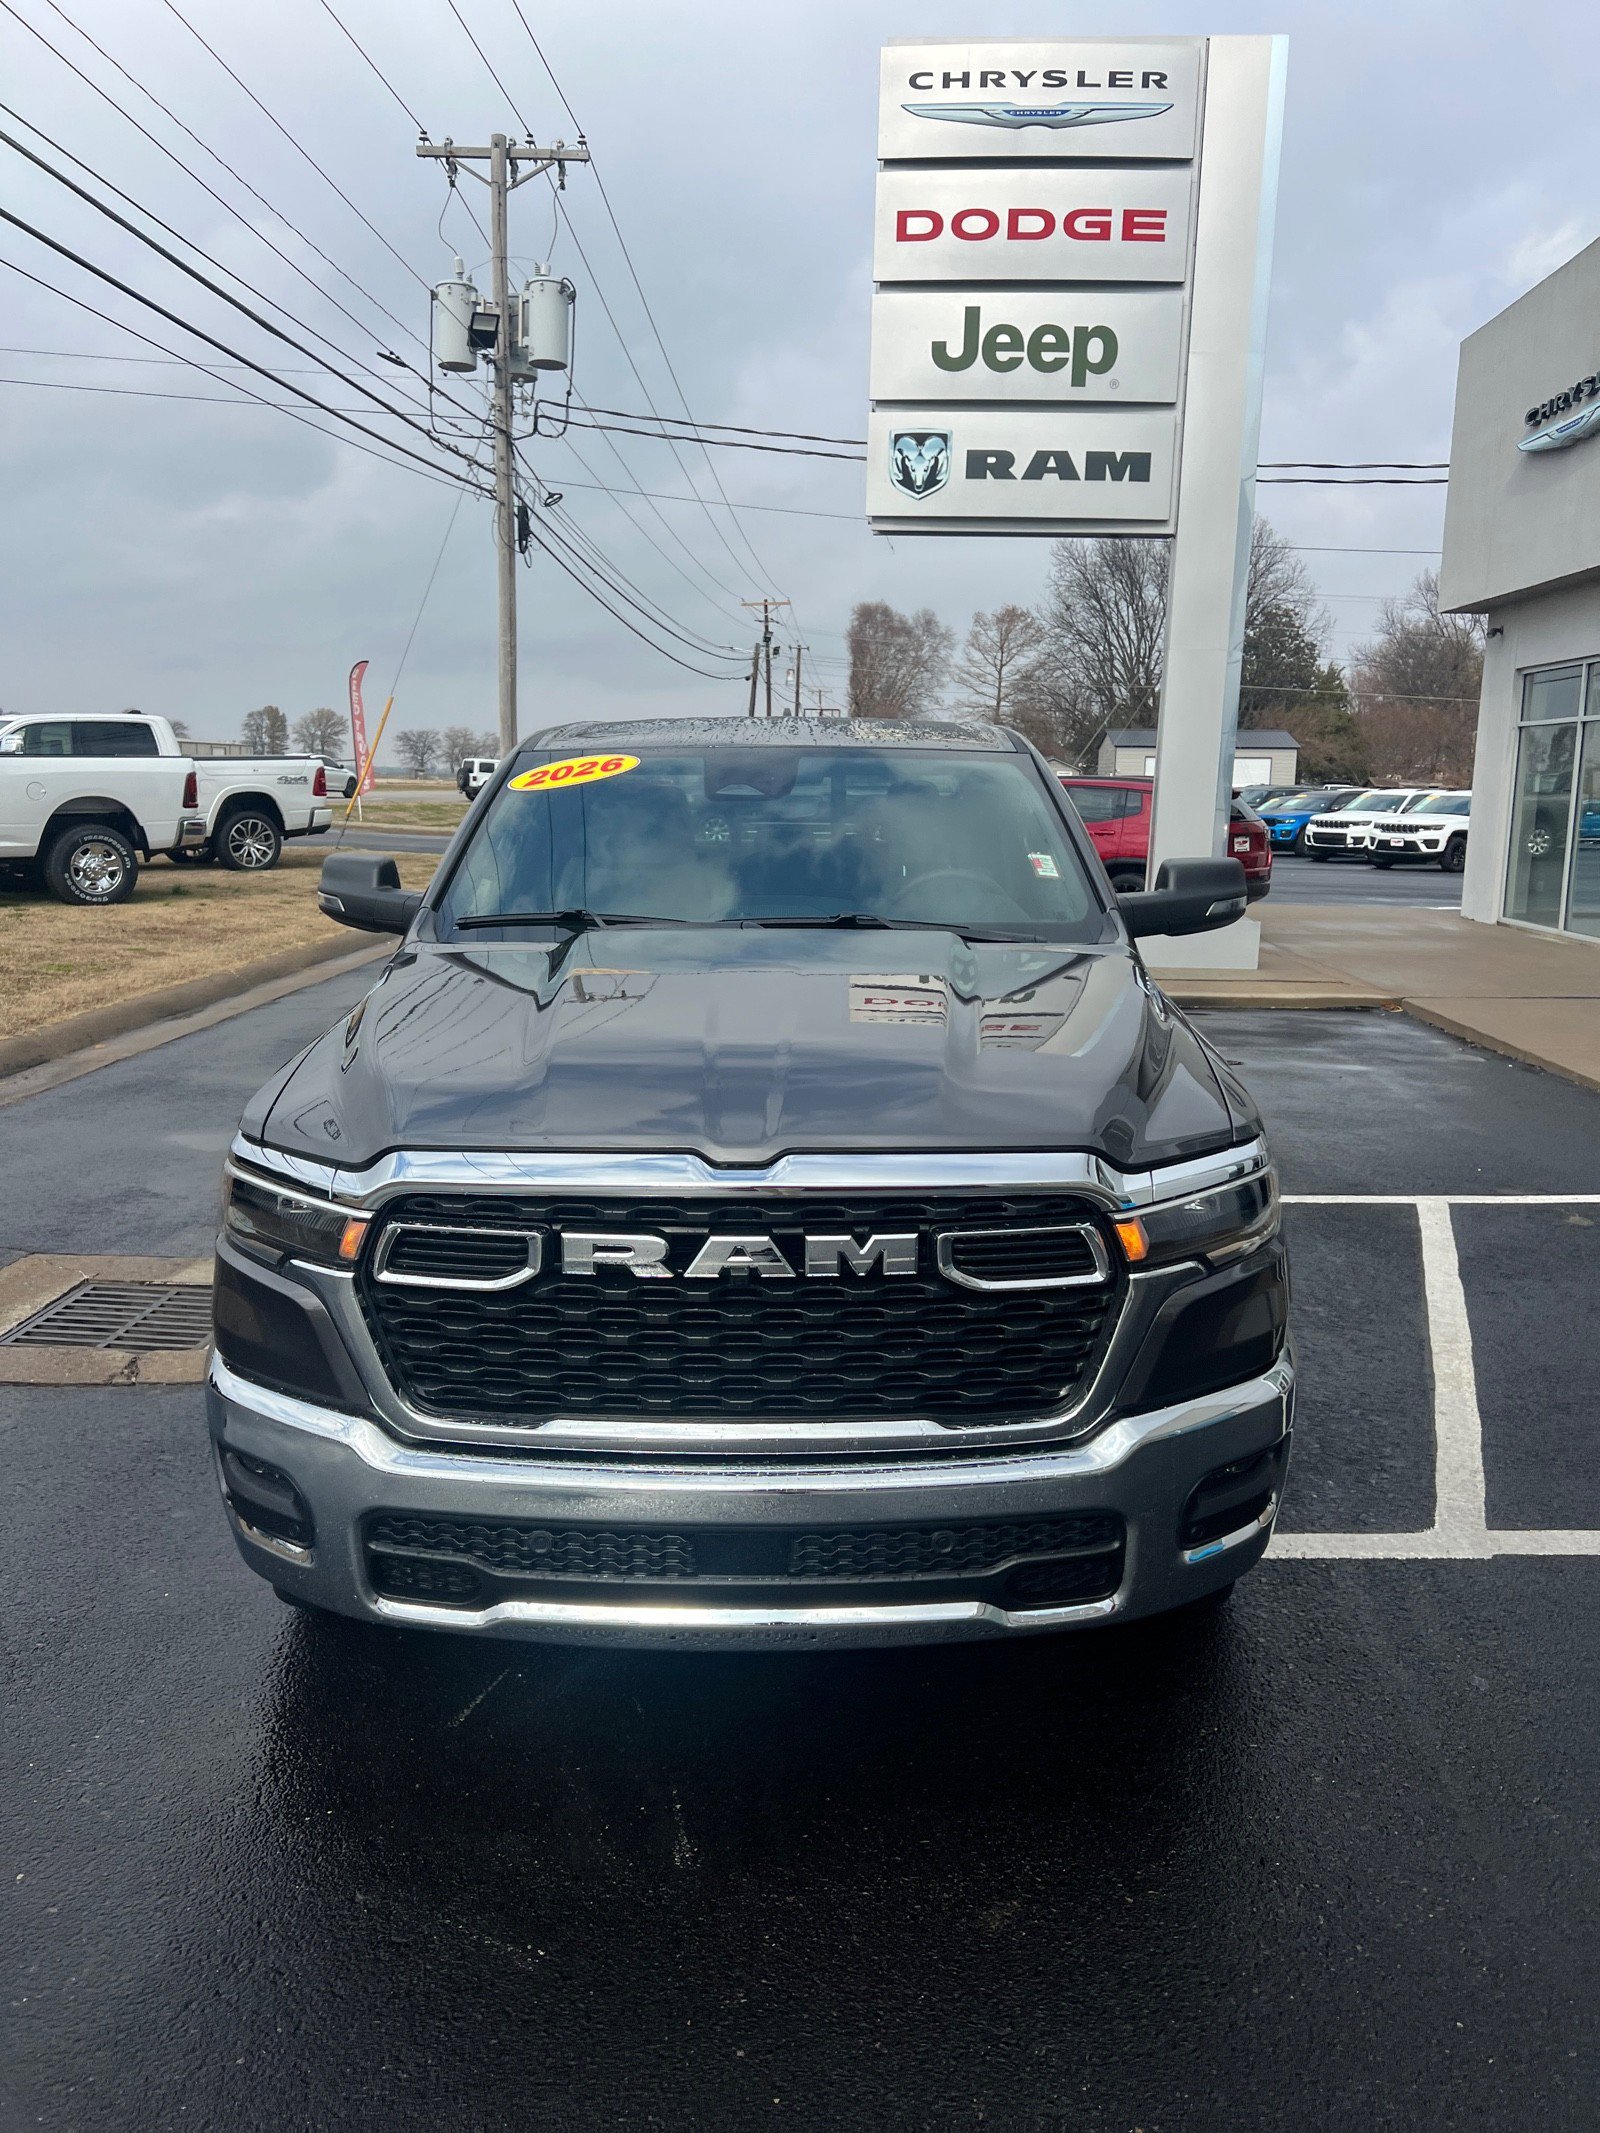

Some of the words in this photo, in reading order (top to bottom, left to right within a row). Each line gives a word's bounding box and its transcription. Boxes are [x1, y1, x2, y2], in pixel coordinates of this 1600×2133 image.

[908, 69, 1168, 91] CHRYSLER
[895, 208, 1168, 242] DODGE
[931, 306, 1118, 388] Jeep
[965, 449, 1152, 483] RAM
[522, 757, 625, 787] 2026
[560, 1232, 920, 1278] RAM
